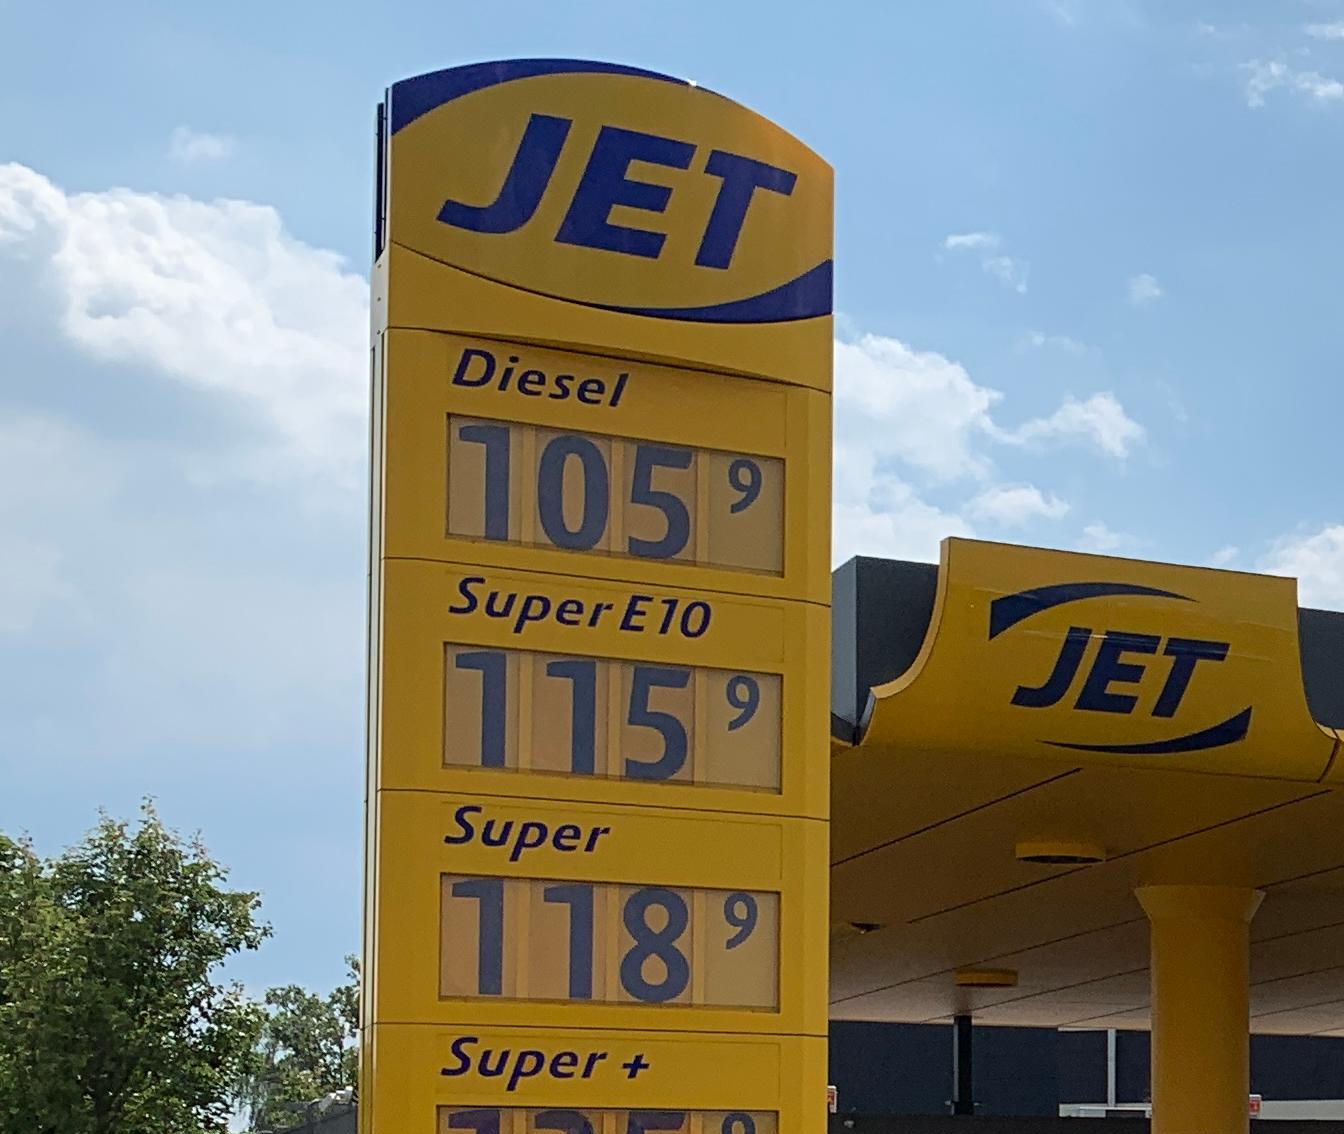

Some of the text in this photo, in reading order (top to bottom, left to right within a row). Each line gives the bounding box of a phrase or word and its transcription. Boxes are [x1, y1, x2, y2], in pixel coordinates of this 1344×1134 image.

[436, 113, 798, 271] JET
[452, 348, 629, 407] Diesel
[1010, 626, 1231, 718] JET
[444, 805, 611, 862] Super
[441, 1036, 607, 1092] Super
